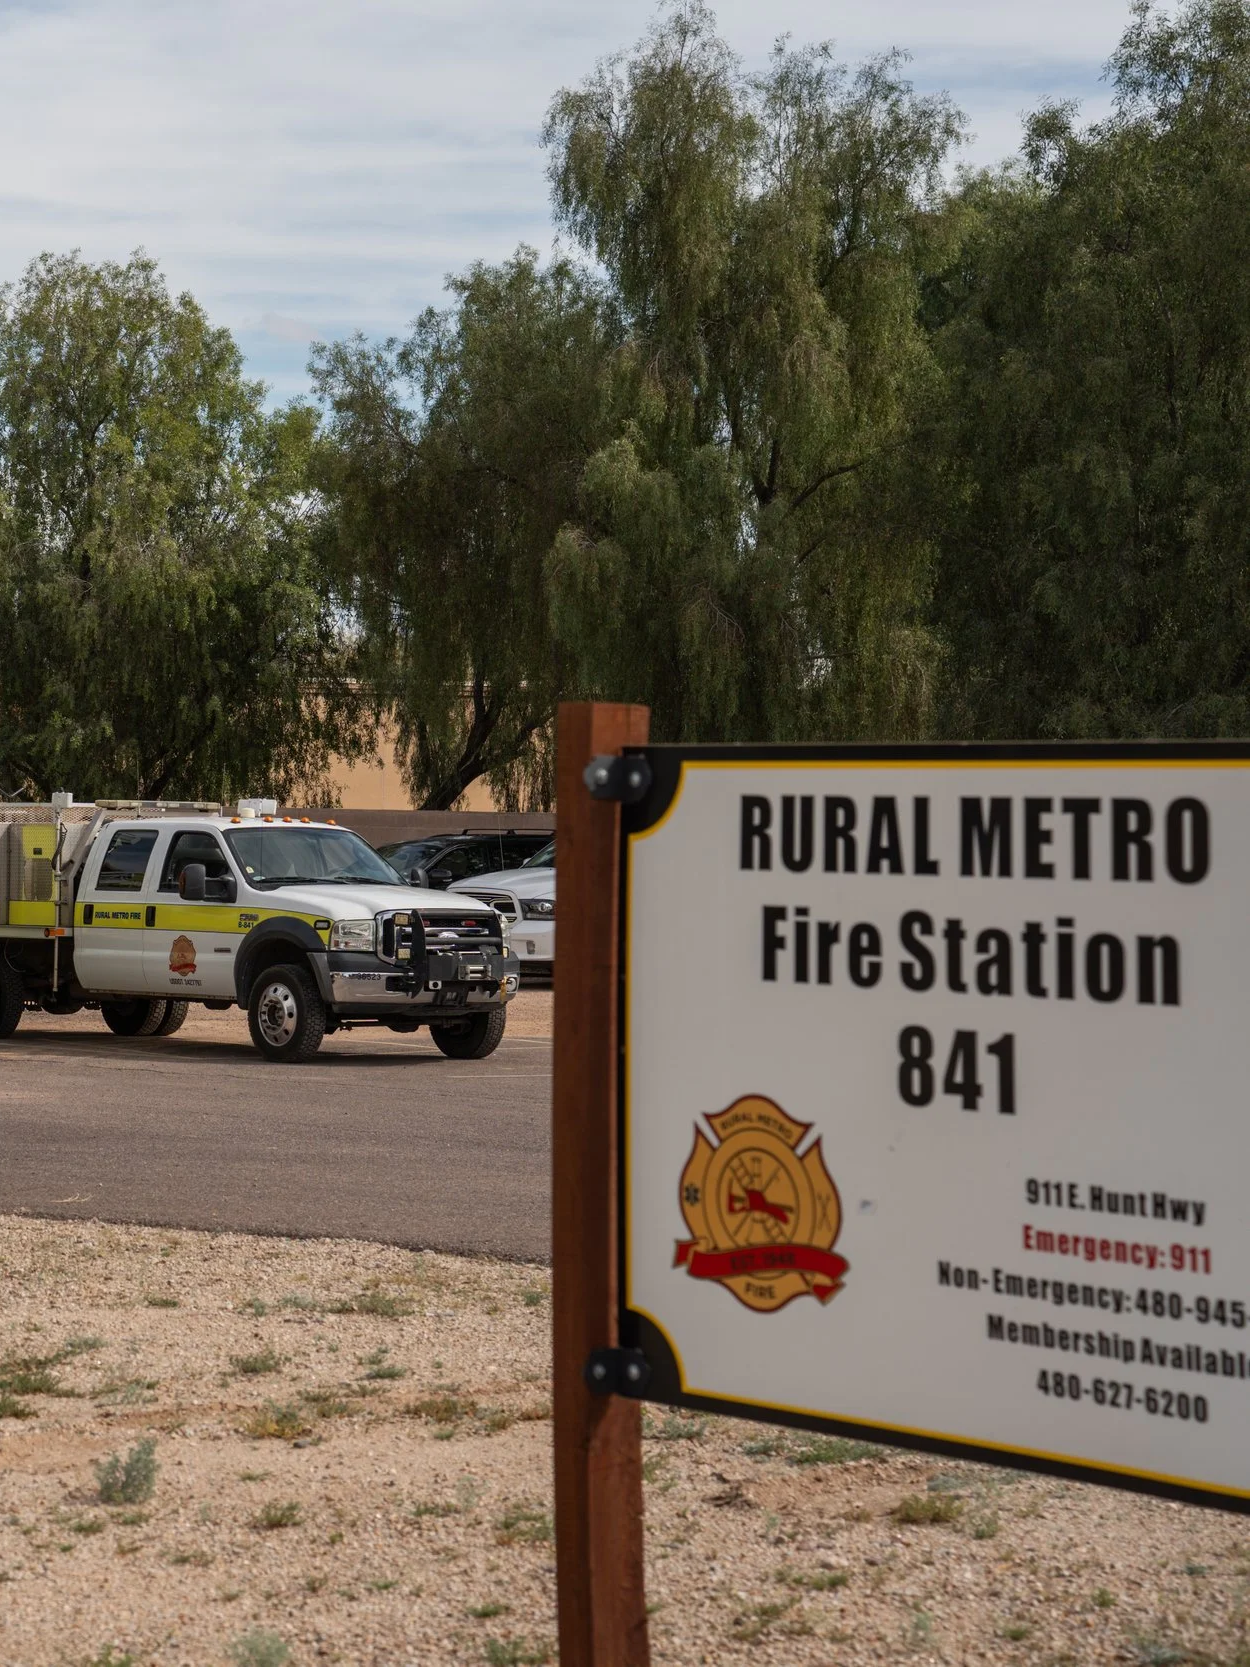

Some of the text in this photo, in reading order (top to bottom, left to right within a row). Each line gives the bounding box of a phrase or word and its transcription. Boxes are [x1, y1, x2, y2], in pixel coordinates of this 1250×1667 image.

[740, 794, 1210, 886] RURAL METRO
[95, 911, 110, 919] RURAL
[130, 912, 141, 920] FIRE
[762, 905, 1181, 1007] Fire Station
[897, 1025, 1016, 1115] 841
[721, 1111, 794, 1140] RURAL METRO
[1026, 1177, 1206, 1227] 911 E. Hunt Hwy
[1022, 1223, 1212, 1275] Emergency: 911
[745, 1281, 776, 1300] FIRE
[986, 1313, 1250, 1380] Membership Availabl
[1037, 1368, 1209, 1424] 480-627-6200
